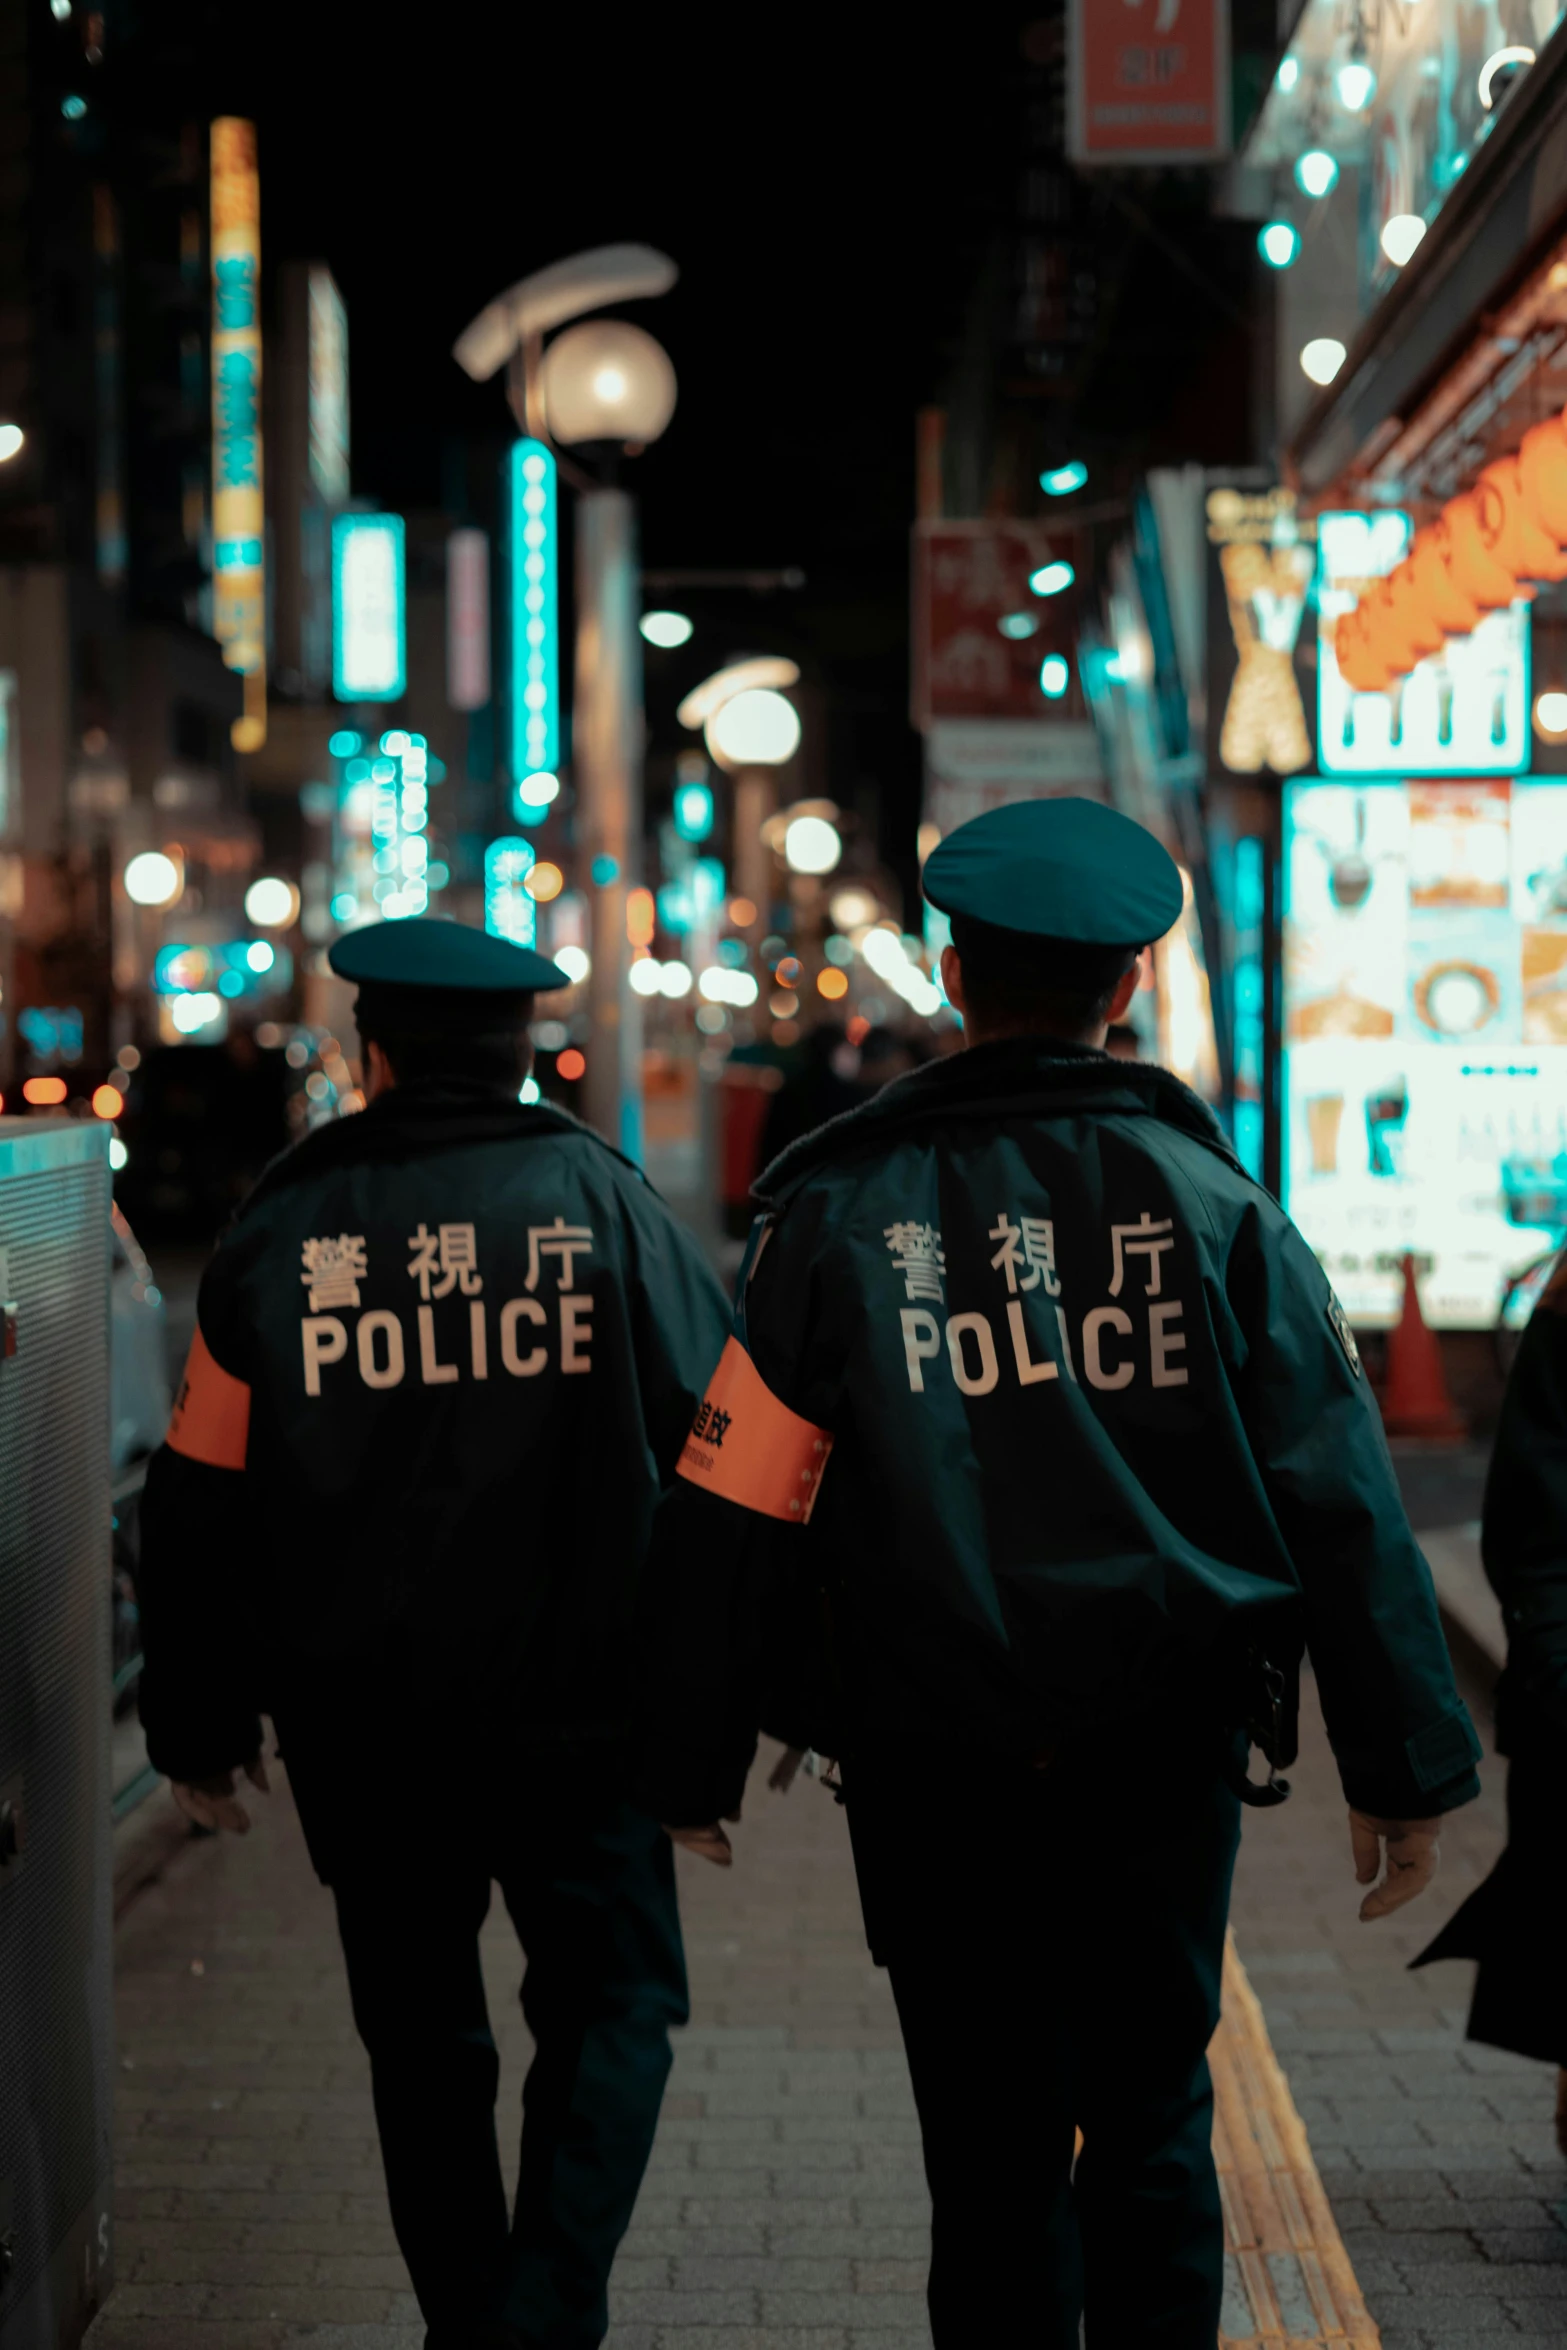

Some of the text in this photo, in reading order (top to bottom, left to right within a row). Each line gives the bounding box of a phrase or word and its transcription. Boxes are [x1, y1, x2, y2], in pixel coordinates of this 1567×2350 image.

[301, 1217, 594, 1312] 警視庁
[884, 1213, 1174, 1303] 警視庁
[301, 1295, 594, 1396] POLICE
[899, 1300, 1188, 1395] POLICE
